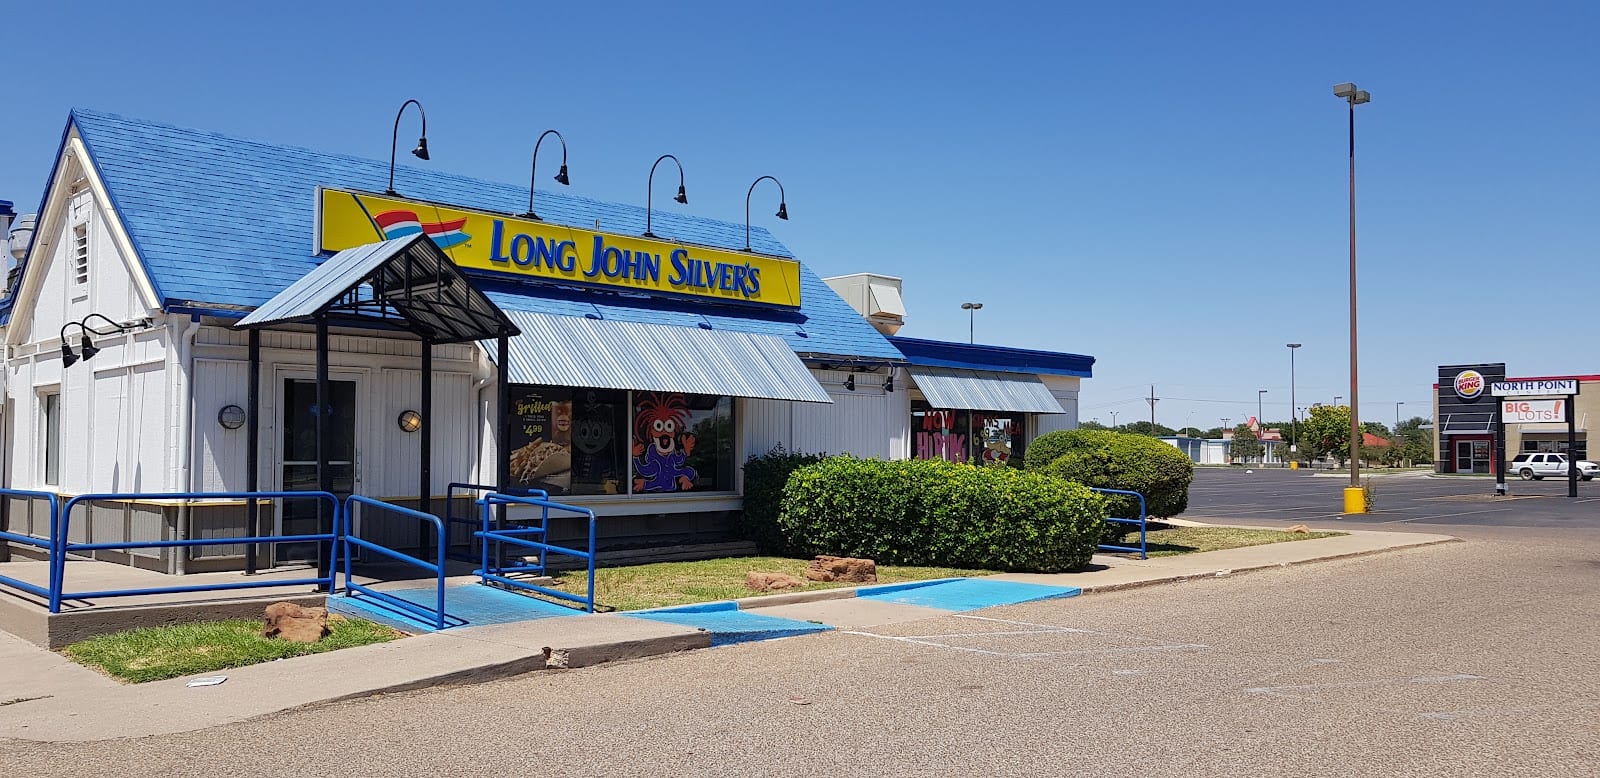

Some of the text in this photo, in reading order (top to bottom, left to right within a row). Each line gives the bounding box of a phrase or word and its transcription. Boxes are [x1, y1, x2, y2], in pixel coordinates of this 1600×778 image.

[489, 219, 761, 298] LONG JOHN SILVER'S
[1458, 376, 1480, 385] BURGER
[1458, 381, 1481, 391] KING
[1493, 380, 1574, 391] NORTH POINT
[1505, 402, 1530, 413] BIG
[922, 409, 956, 430] NOW
